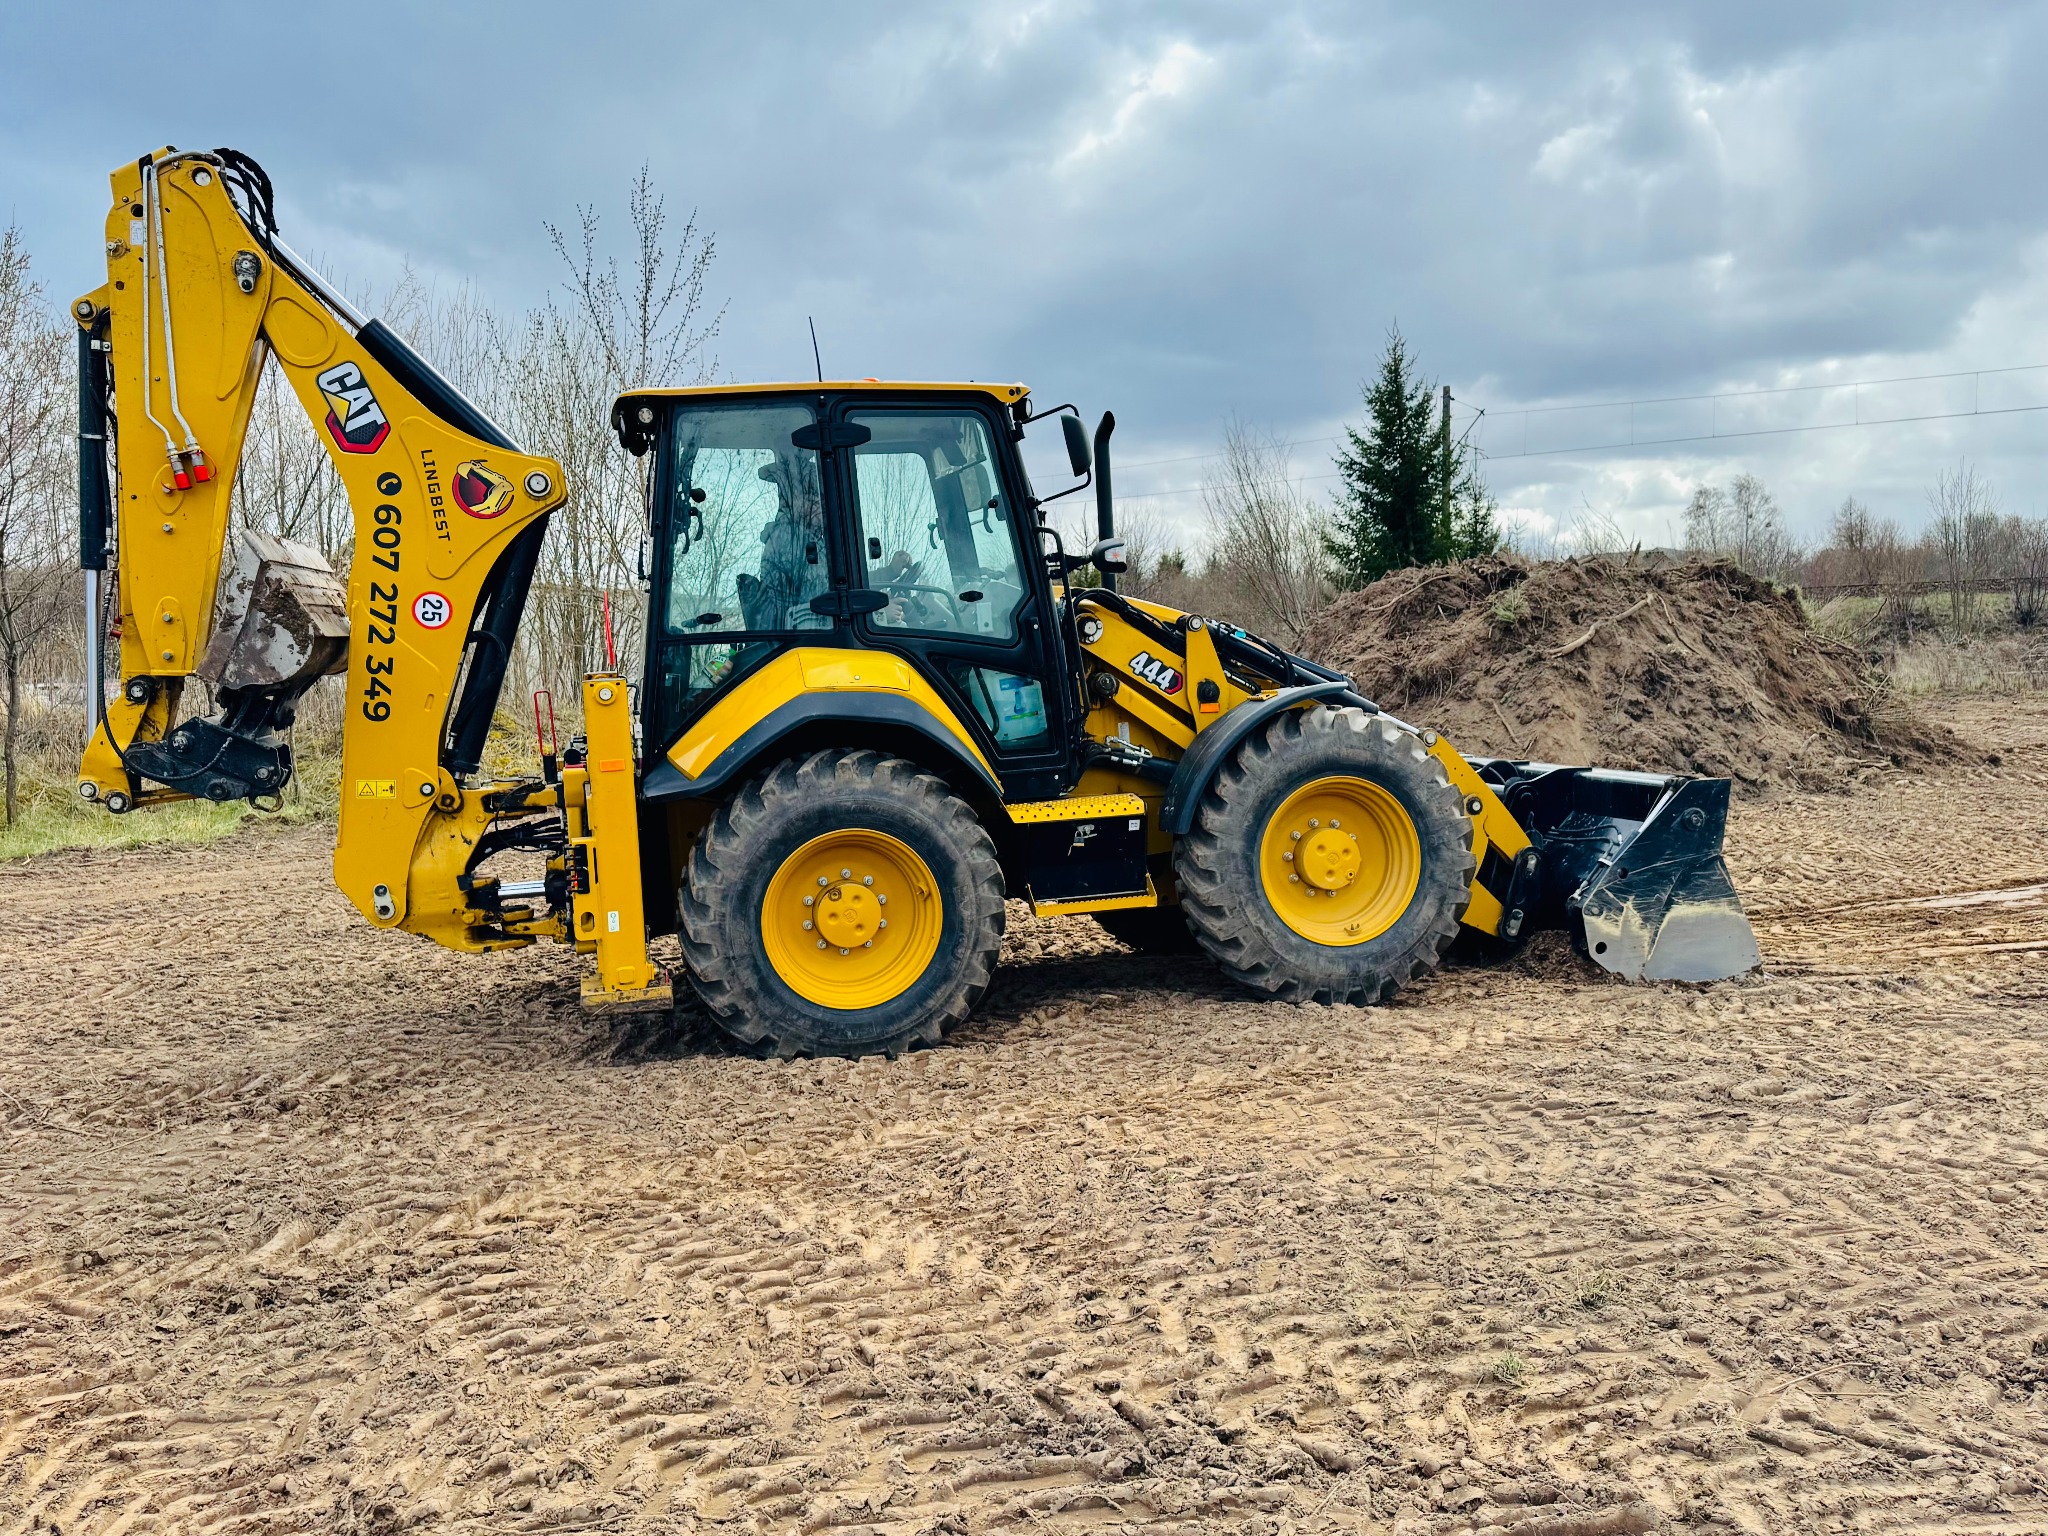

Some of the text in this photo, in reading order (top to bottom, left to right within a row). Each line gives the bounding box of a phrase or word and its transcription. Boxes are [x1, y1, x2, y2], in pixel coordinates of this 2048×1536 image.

[319, 362, 387, 432] CAT
[421, 449, 451, 541] LINGBEST
[363, 504, 402, 722] 607 272 349
[421, 598, 443, 622] 25
[1129, 652, 1175, 690] 444
